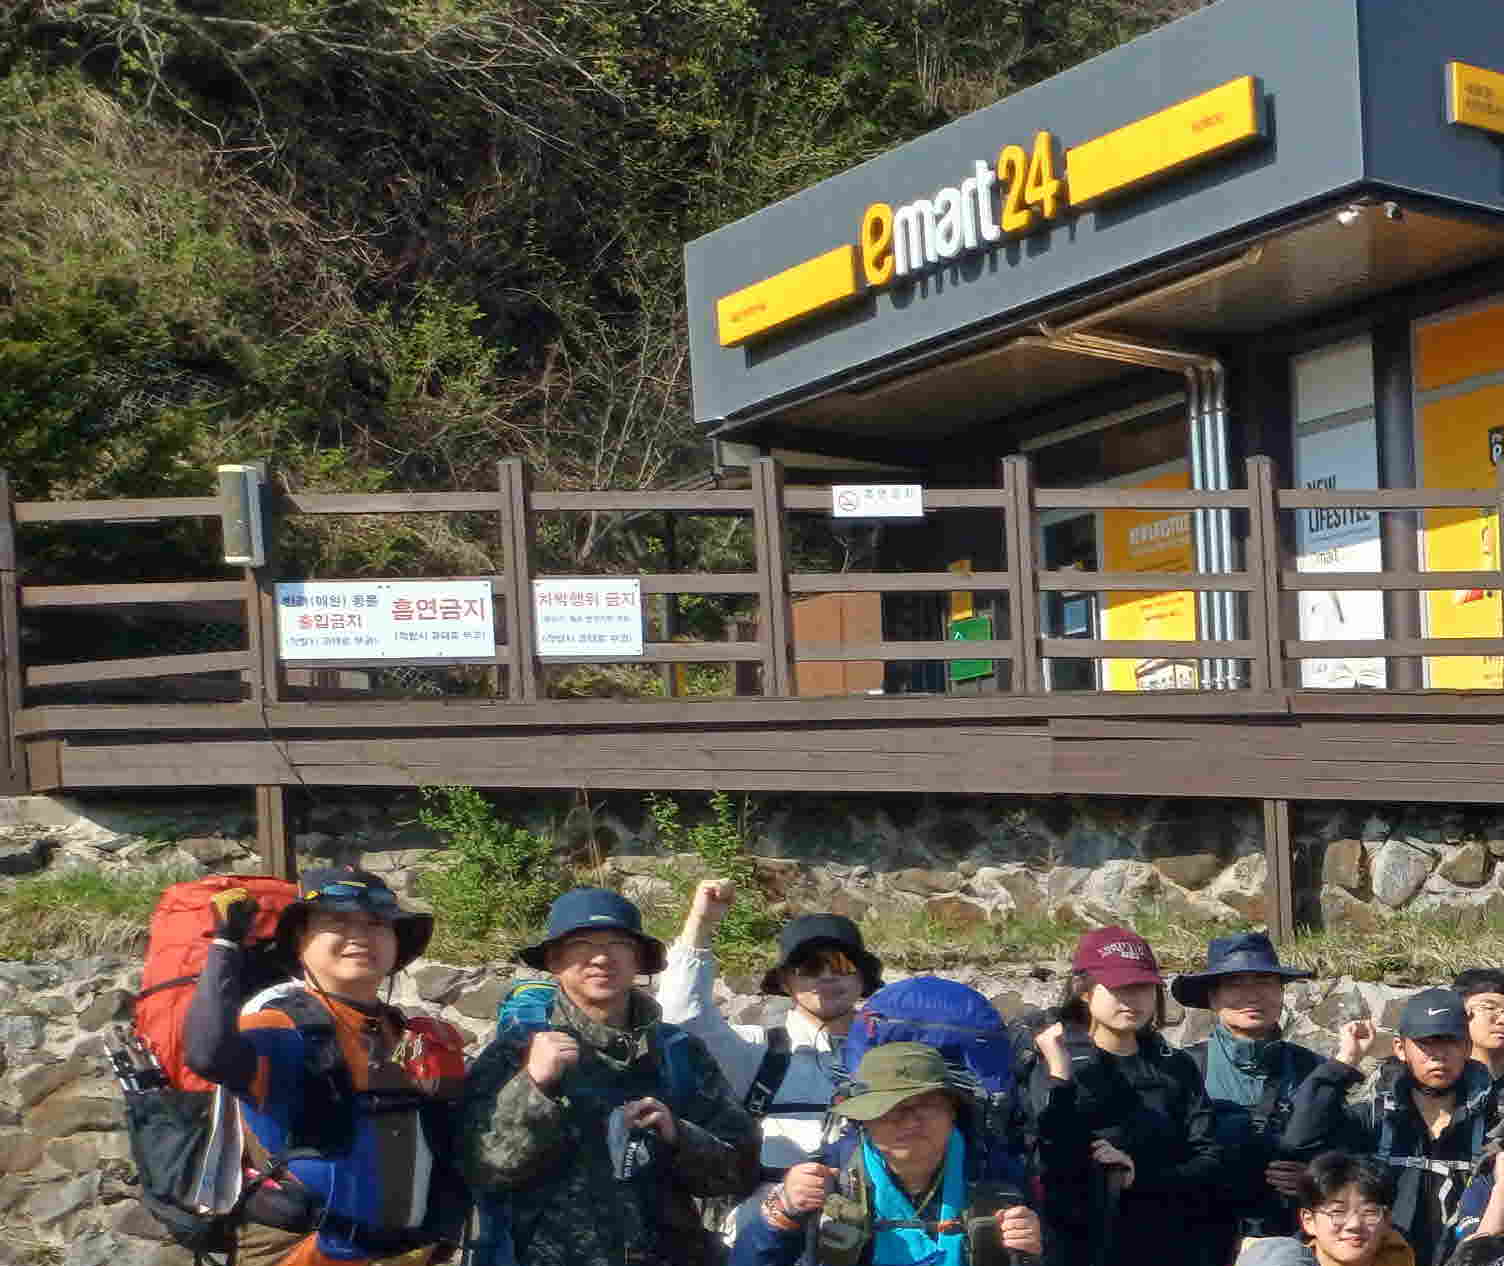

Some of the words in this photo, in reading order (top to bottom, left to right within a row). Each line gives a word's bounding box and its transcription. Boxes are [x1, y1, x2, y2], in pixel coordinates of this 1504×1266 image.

[860, 129, 1061, 286] emart24
[1308, 507, 1372, 532] LIFESTYLE
[391, 597, 486, 622] 흡연금지
